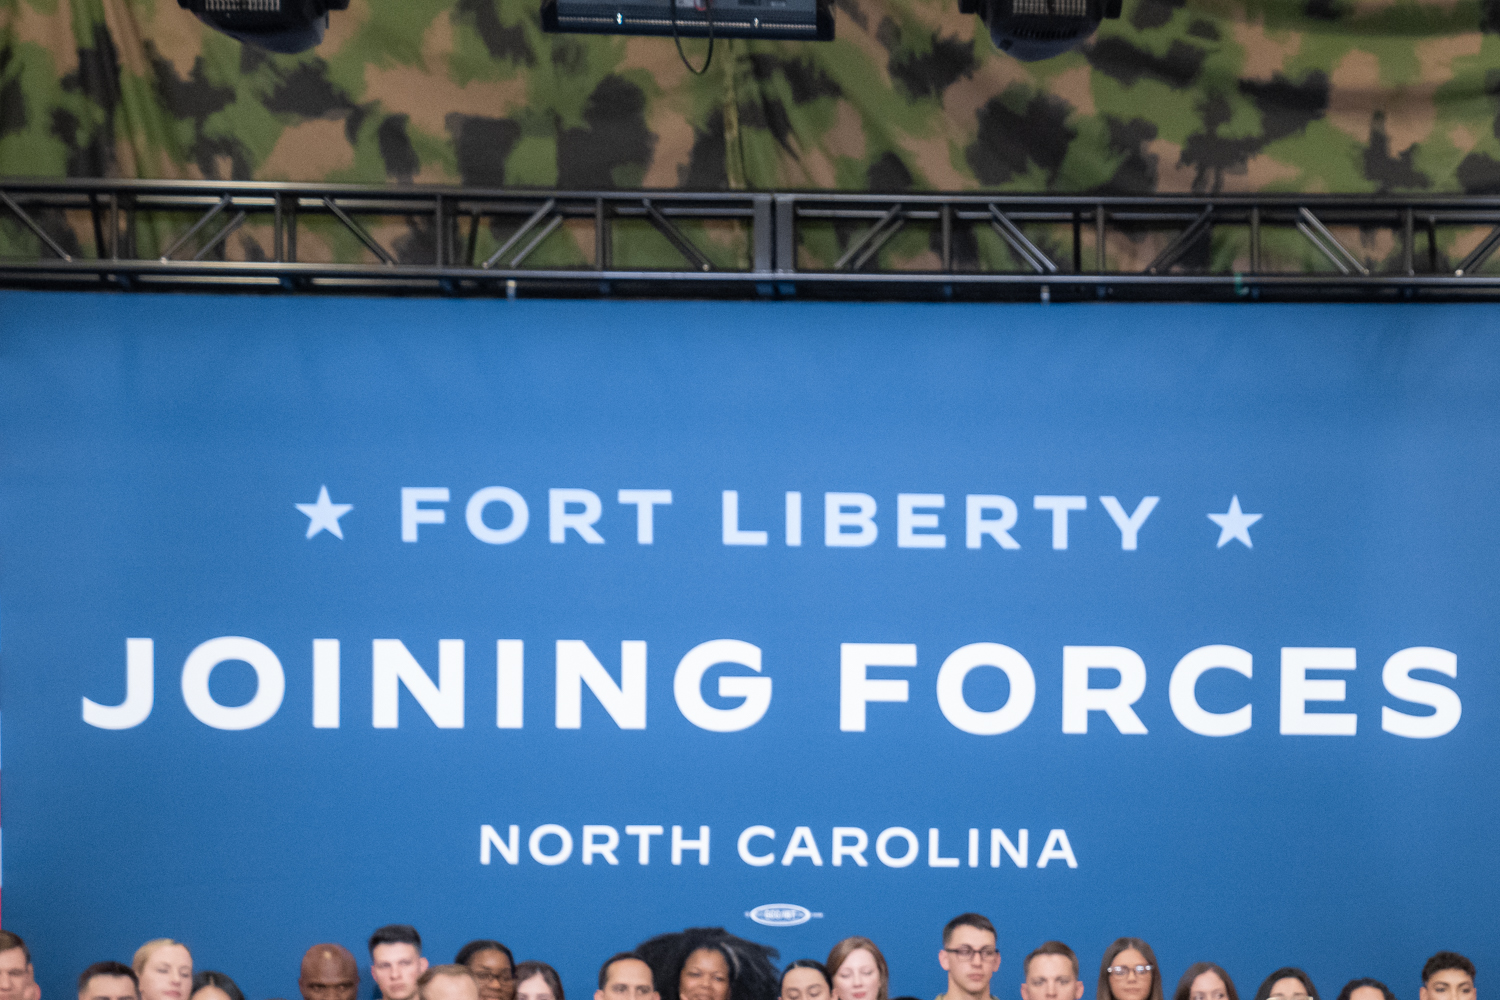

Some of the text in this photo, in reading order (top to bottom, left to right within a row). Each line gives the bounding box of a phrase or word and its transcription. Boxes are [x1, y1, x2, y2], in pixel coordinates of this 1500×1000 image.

[402, 486, 1161, 552] FORT LIBERTY
[83, 636, 1464, 740] JOINING FORCES
[480, 824, 1079, 870] NORTH CAROLINA
